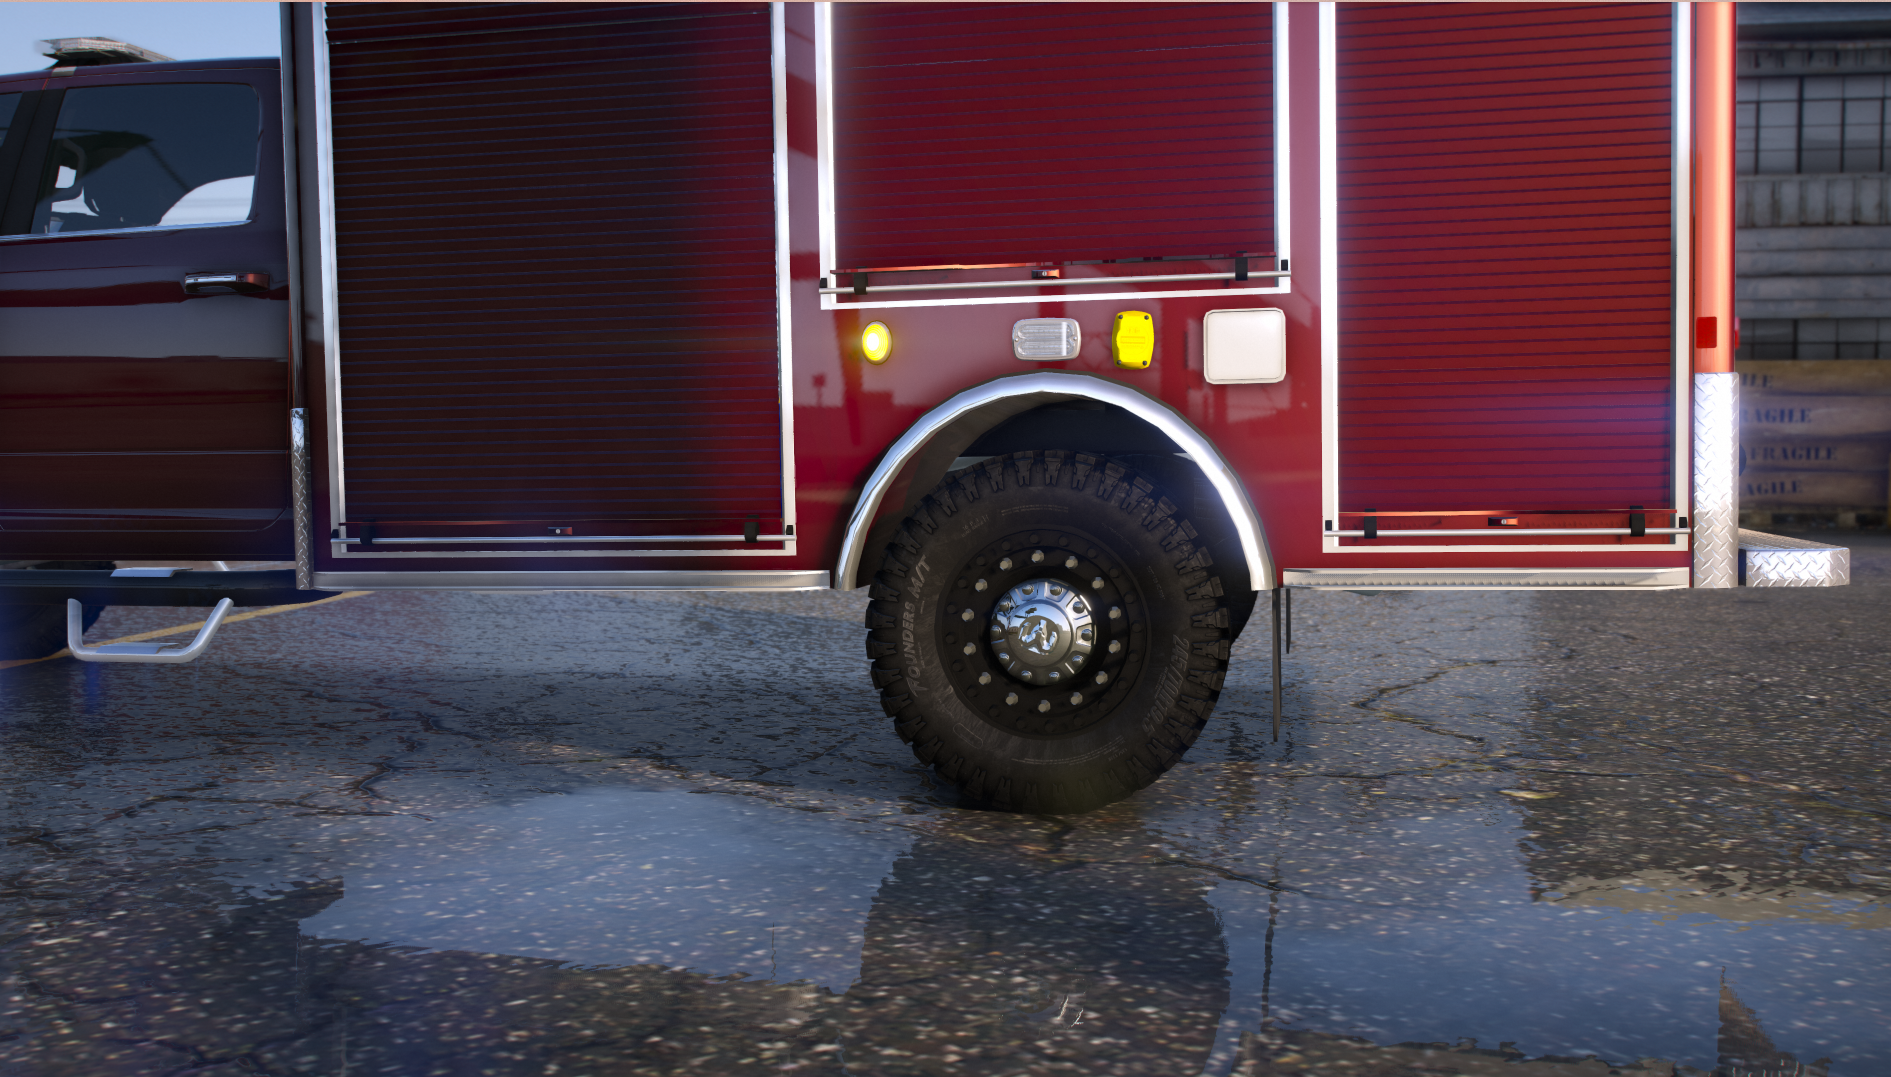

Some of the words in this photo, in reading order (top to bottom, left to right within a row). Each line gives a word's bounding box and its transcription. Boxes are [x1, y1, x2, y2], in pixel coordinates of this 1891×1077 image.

[1750, 446, 1838, 461] FRAGILE
[1740, 480, 1803, 497] AGILE
[907, 554, 931, 599] M/T
[1141, 634, 1190, 737] 245/70R19.5
